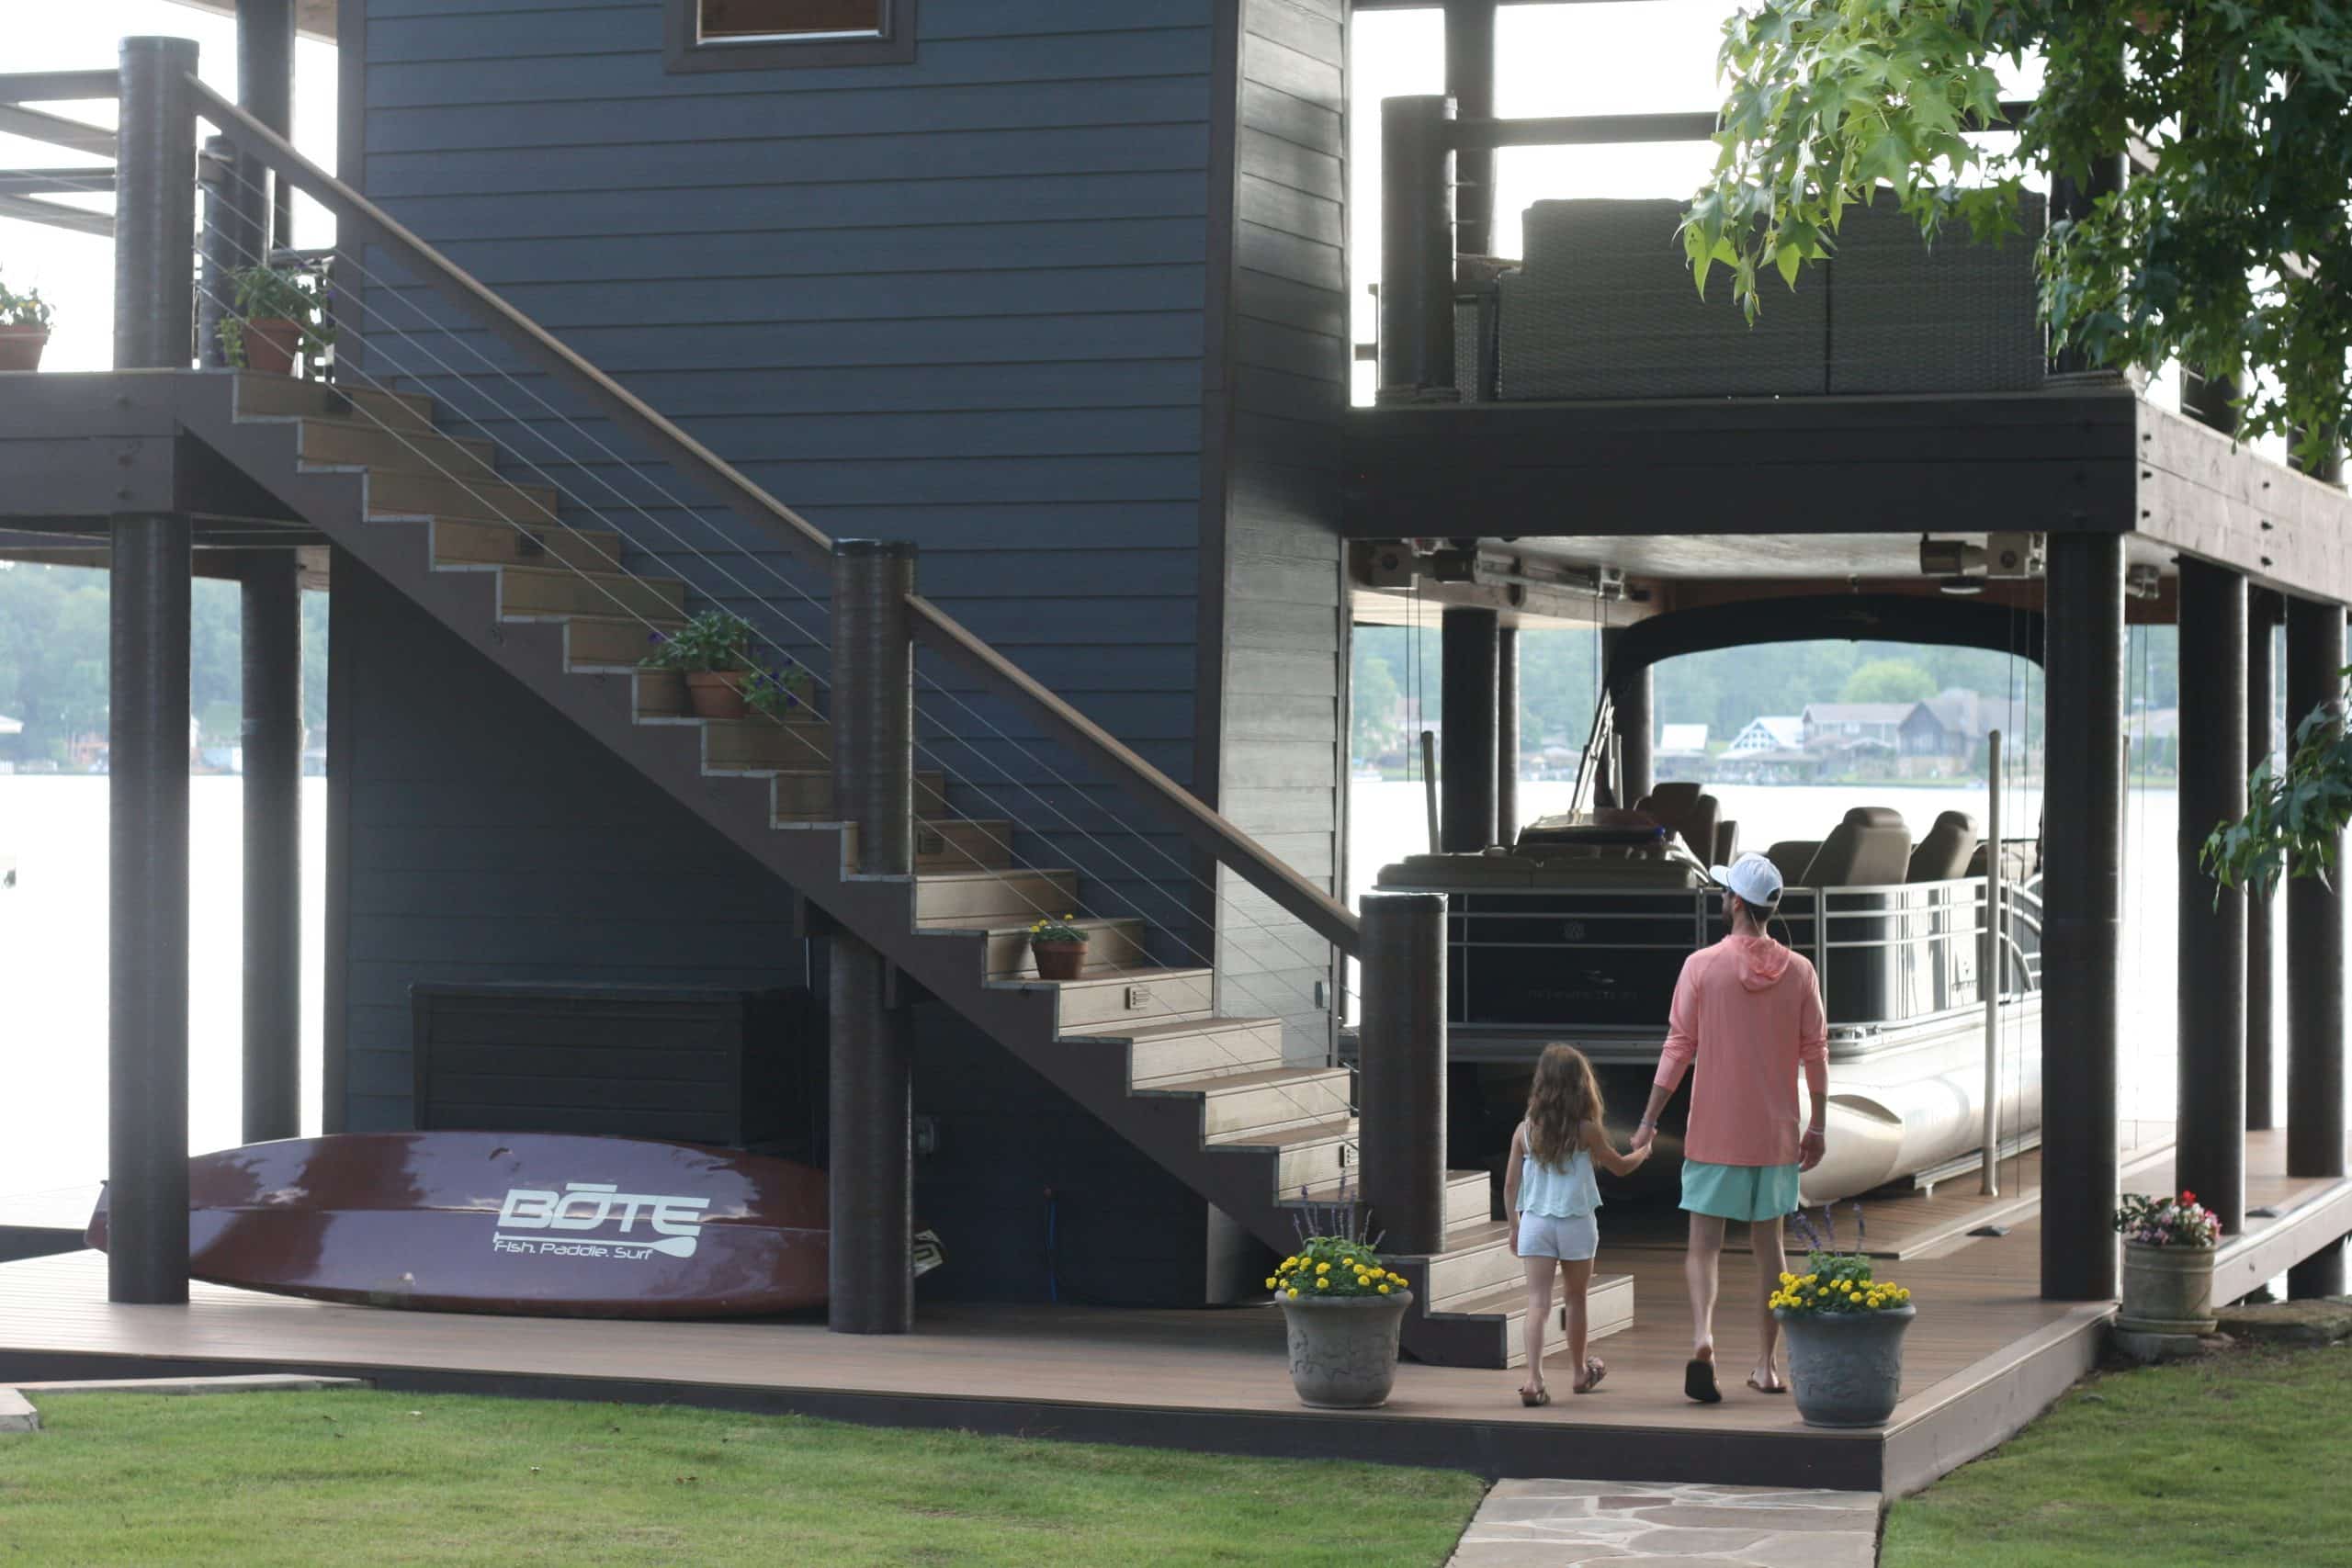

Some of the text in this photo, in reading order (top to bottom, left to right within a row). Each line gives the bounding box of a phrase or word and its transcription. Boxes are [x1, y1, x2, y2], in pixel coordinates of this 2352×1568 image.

[493, 1241, 654, 1260] Fish. Paddle. Surf
